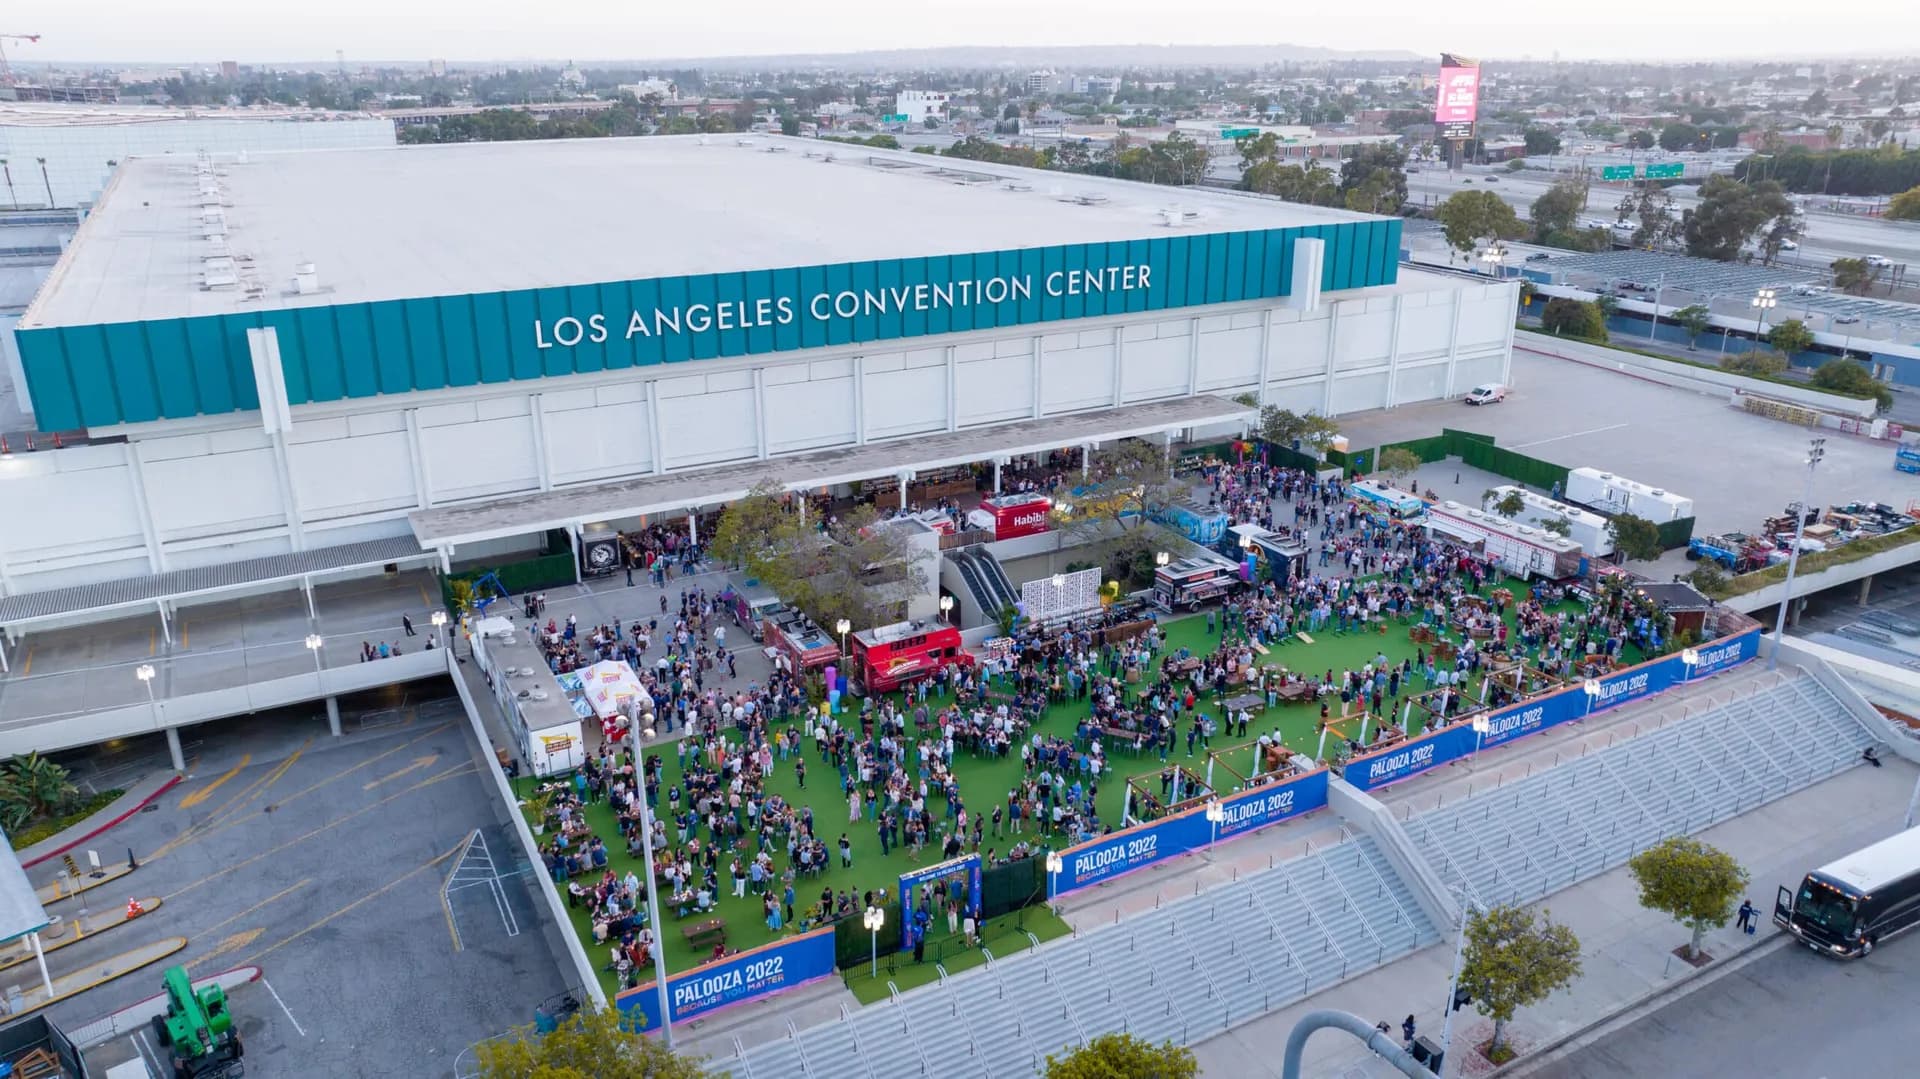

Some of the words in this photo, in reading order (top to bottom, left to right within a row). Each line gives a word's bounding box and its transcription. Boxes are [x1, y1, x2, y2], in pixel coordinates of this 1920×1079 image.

[535, 314, 608, 348] LOS
[625, 297, 793, 340] ANGELES
[810, 274, 1032, 321] CONVENTION
[1046, 264, 1151, 297] CENTER
[1014, 511, 1045, 527] Habibi
[1629, 672, 1648, 690] 2022
[1521, 706, 1543, 725] 2022
[1370, 752, 1410, 778] PALOOZA
[1411, 743, 1434, 764] 2022
[1220, 799, 1266, 827] PALOOZA
[1268, 790, 1294, 811] 2022
[1075, 844, 1126, 876] PALOOZA
[1128, 834, 1157, 857] 2022
[1075, 865, 1111, 884] BECAUSE
[1111, 860, 1128, 871] YOU
[1128, 850, 1157, 865] MATTER
[674, 969, 743, 1007] PALOOZA
[745, 955, 784, 983] 2022
[676, 994, 722, 1016] BECAUSE
[725, 986, 746, 998] YOU
[747, 973, 785, 992] MATTER
